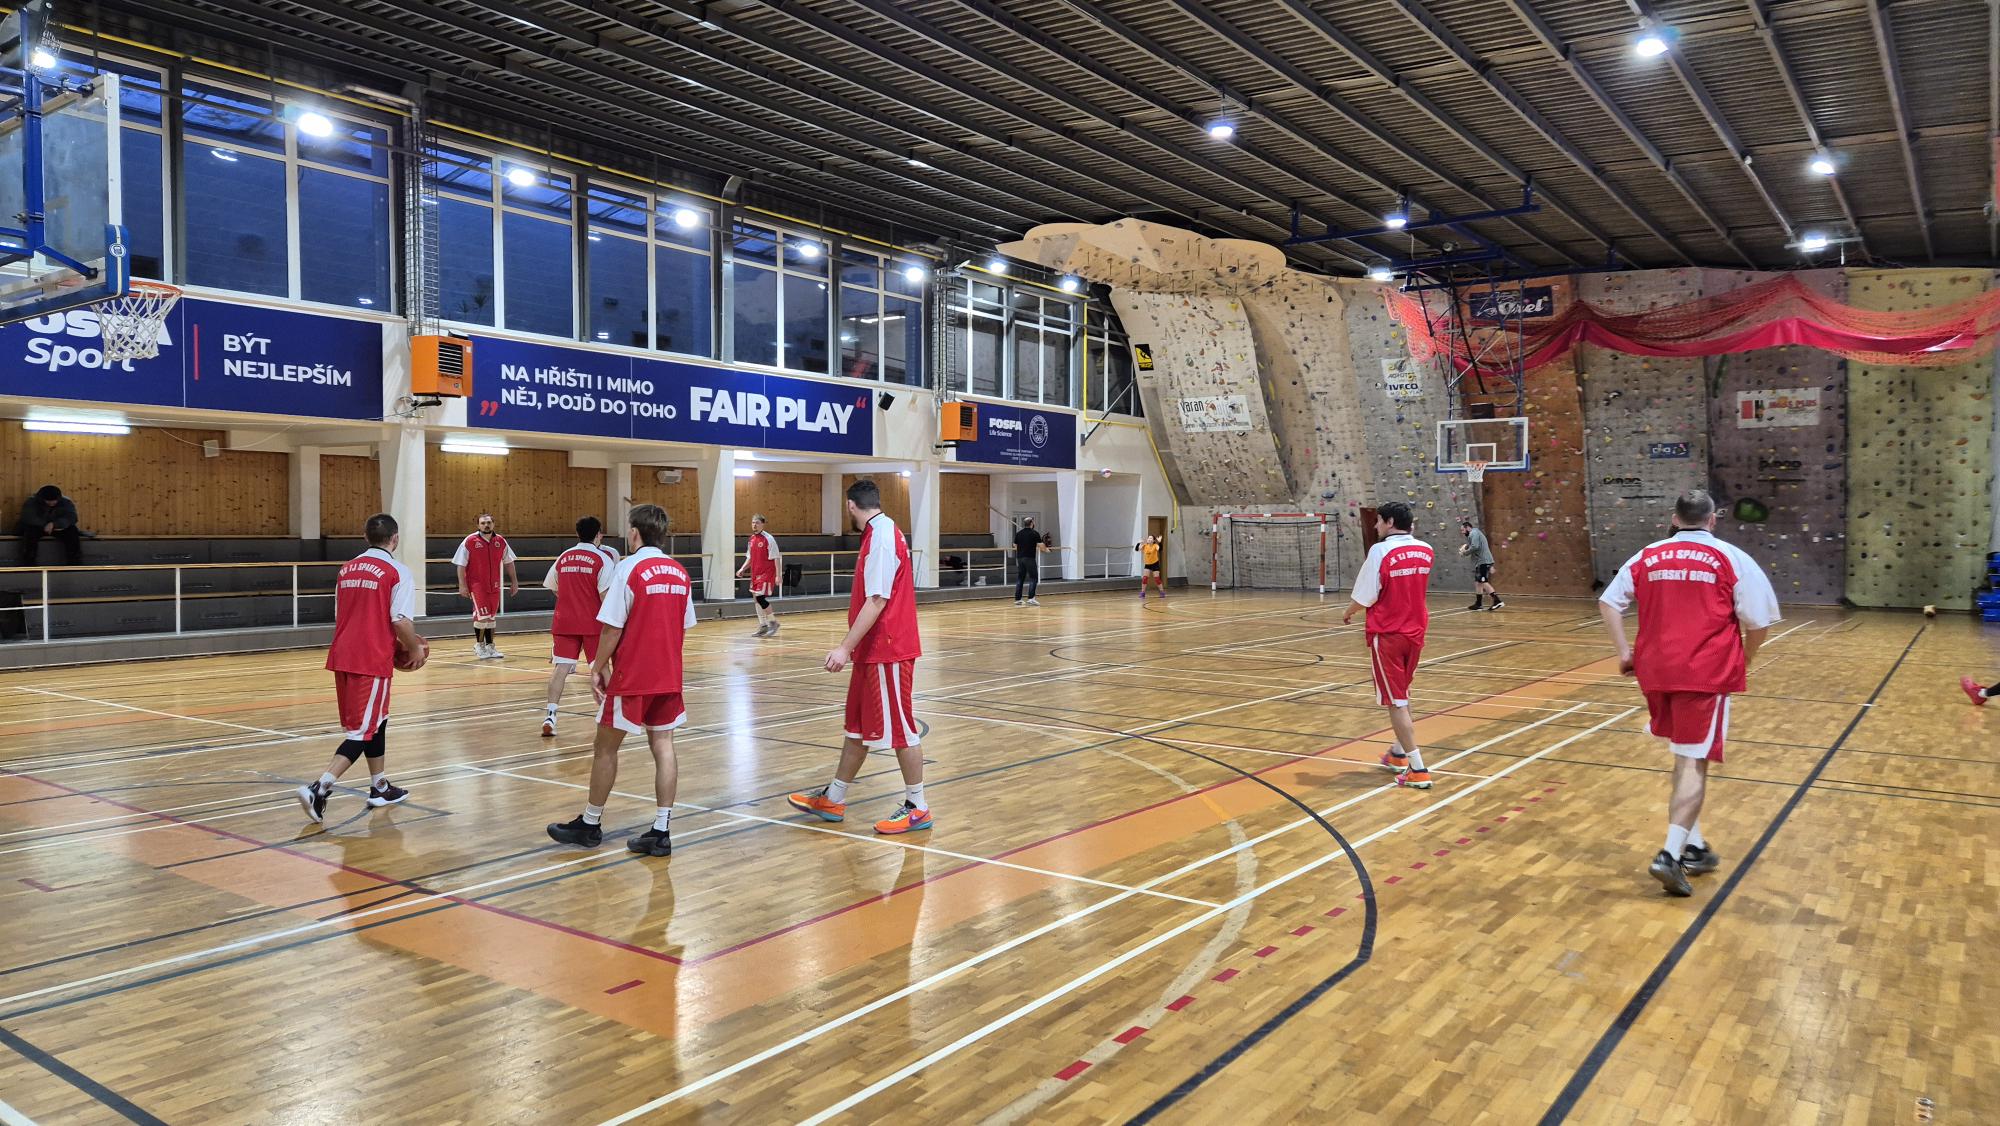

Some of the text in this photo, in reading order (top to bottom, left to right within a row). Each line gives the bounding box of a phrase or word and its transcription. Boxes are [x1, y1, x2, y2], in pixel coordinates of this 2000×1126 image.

[223, 332, 271, 355] BÝT
[223, 358, 352, 387] NEJLEPŠÍM
[501, 363, 654, 396] NA HŘIŠTI I MIMO
[501, 385, 677, 419] NĚJ, POJĎ DO TOHO
[690, 386, 854, 435] FAIR PLAY
[989, 418, 1023, 431] FOSFA
[357, 563, 386, 579] SPARTAK
[1676, 549, 1721, 570] SPARTAK
